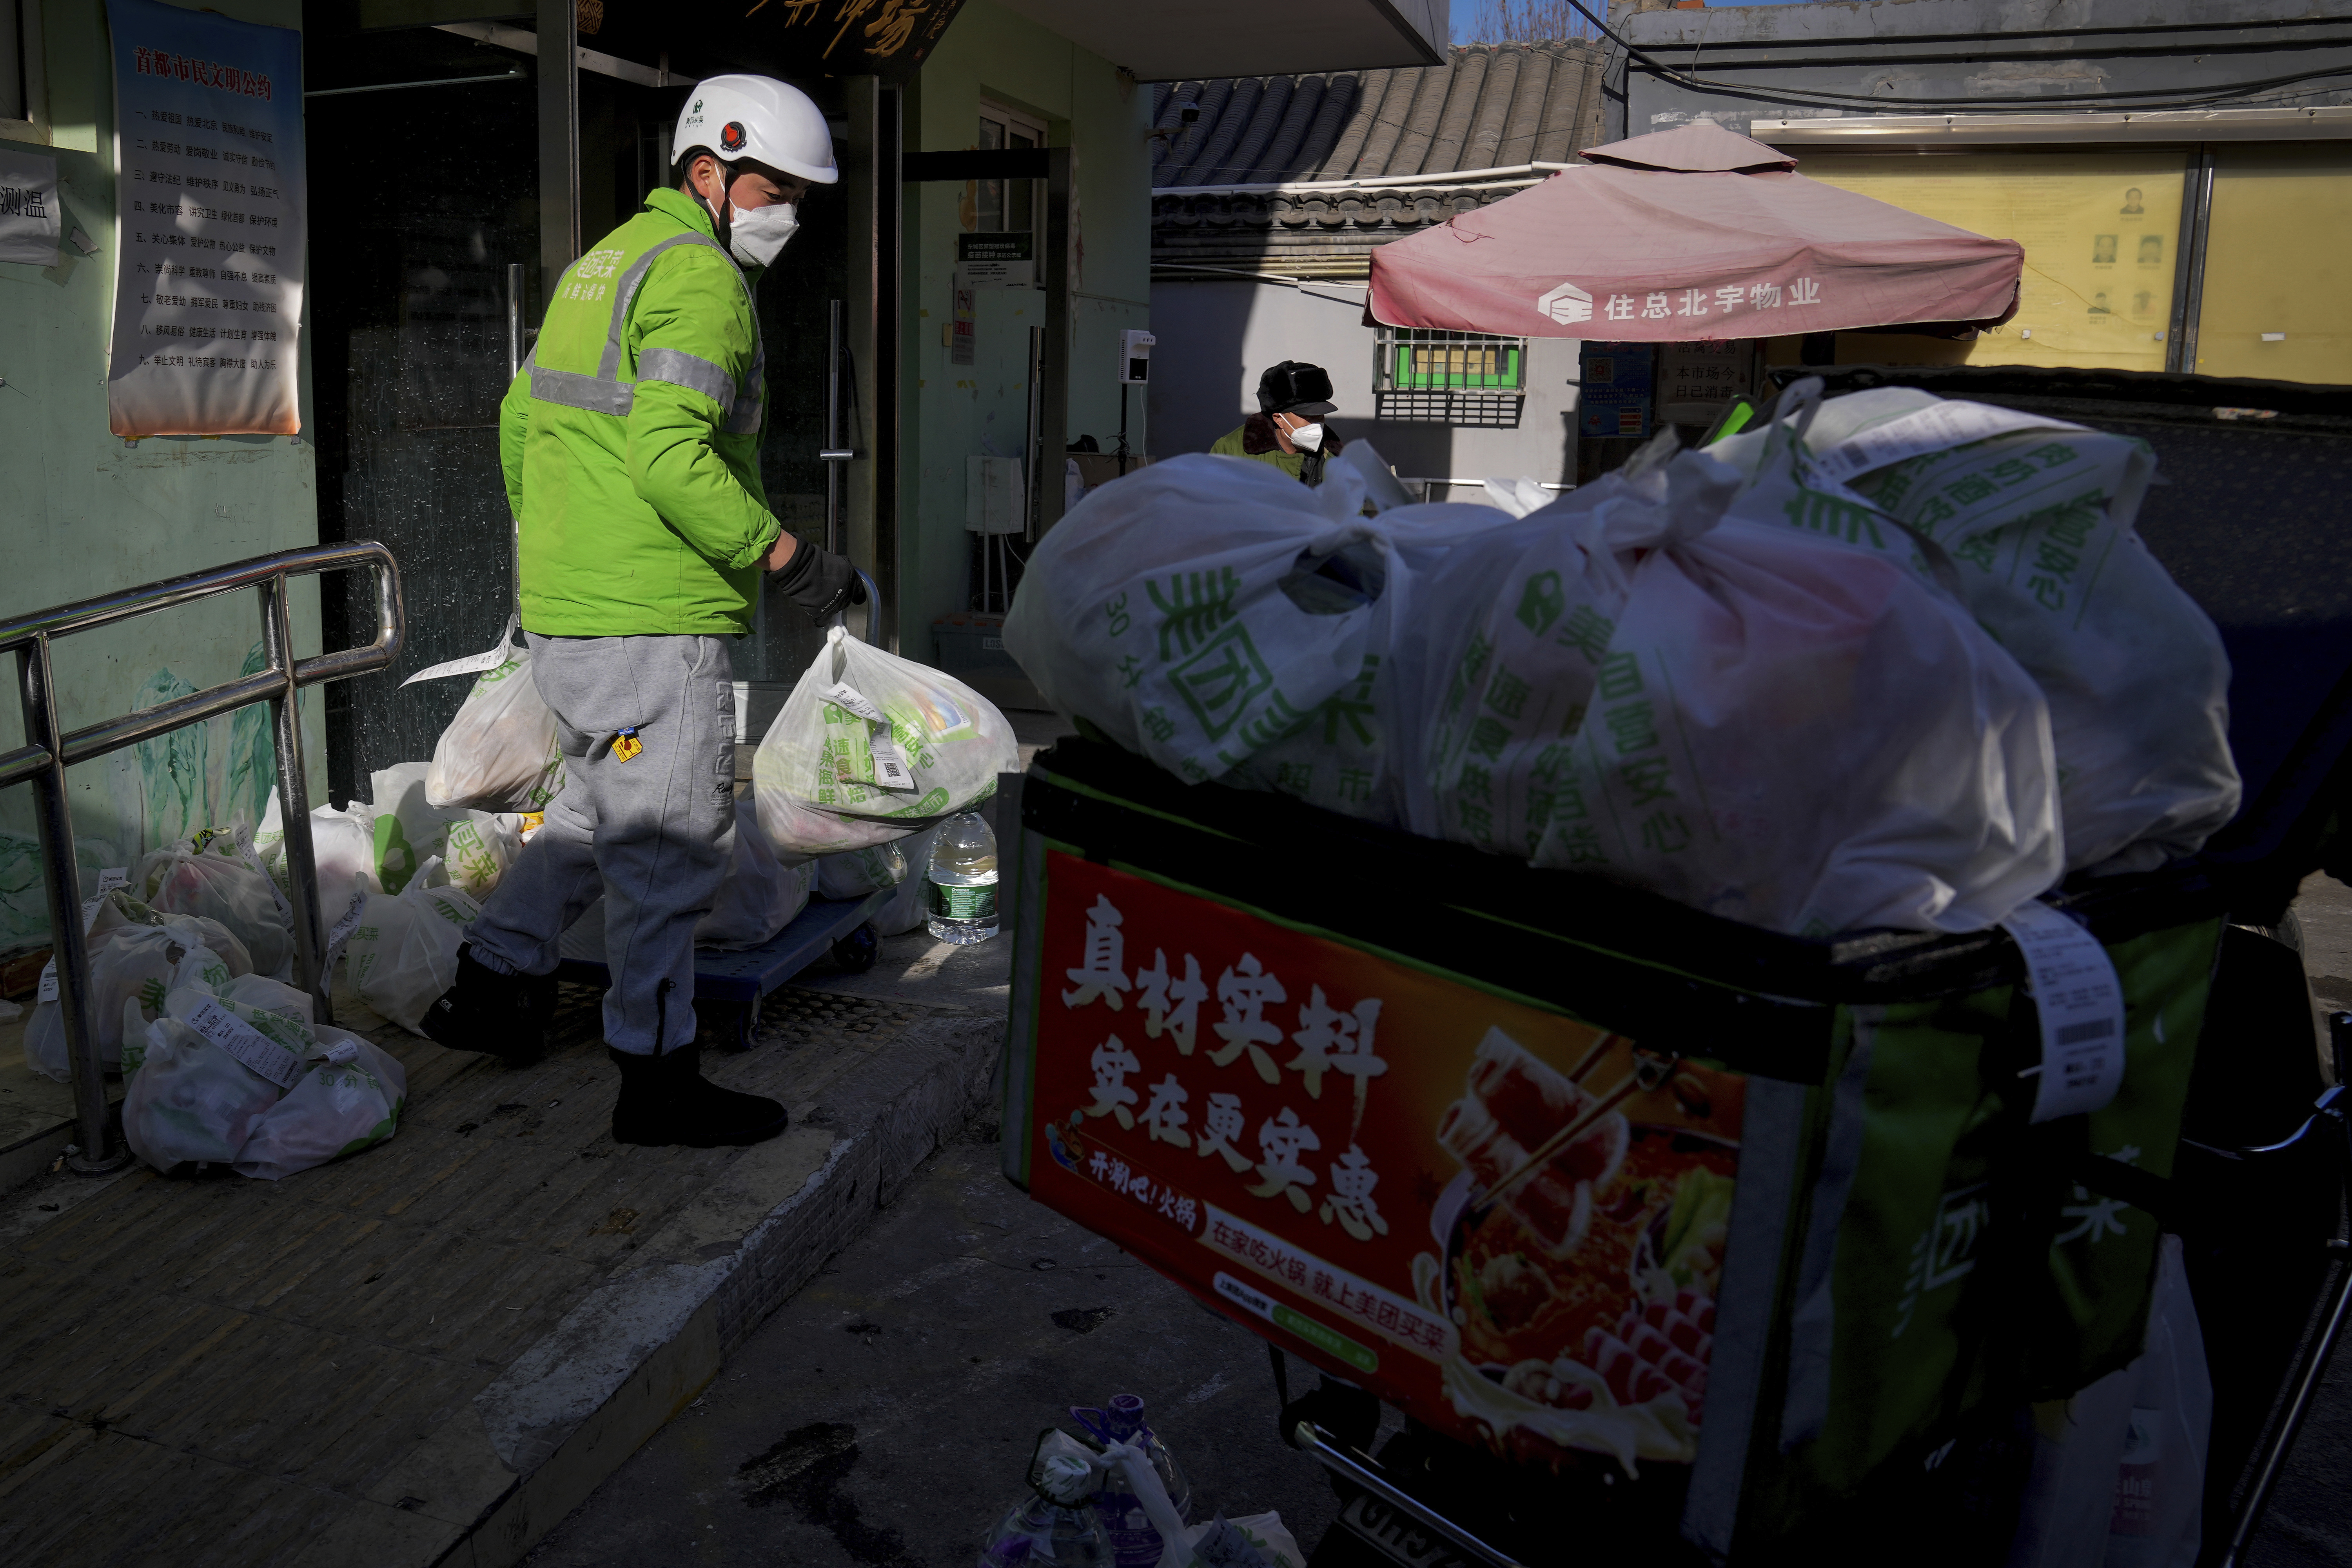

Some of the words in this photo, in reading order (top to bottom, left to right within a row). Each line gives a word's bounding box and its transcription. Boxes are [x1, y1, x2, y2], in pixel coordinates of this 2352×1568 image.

[133, 46, 272, 102] 首都市民文明公约
[187, 116, 218, 130] 热爱北京
[222, 122, 246, 137] 民族和睦
[249, 129, 272, 143] 维护安定
[186, 146, 218, 160] 爱岗敬业
[223, 151, 248, 165] 诚实守信
[251, 157, 275, 171] 勤俭节约
[186, 176, 218, 189] 维护秩序
[223, 181, 245, 194] 见义勇为
[251, 186, 279, 199] 弘扬正气
[0, 185, 47, 218] 测温
[189, 207, 217, 220] 讲究卫生
[221, 211, 245, 224] 绿化首都
[250, 215, 278, 228] 保护环境
[191, 237, 215, 249] 爱护公物
[220, 241, 245, 252] 热心公益
[249, 244, 276, 256] 保护文物
[189, 267, 216, 279] 重教尊师
[221, 269, 247, 281] 自强不息
[252, 272, 276, 285] 提高素质
[191, 297, 218, 309] 拥军爱民
[223, 299, 249, 311] 尊重妇女
[253, 302, 277, 312] 助残济困
[1604, 277, 1821, 320] 住总北宇物业
[189, 328, 216, 338] 健康生活
[220, 328, 247, 340] 计划生育
[251, 330, 276, 341] 增强体魄
[189, 356, 216, 368] 礼待宾客
[220, 358, 246, 369] 胸襟大度
[251, 359, 276, 370] 助人为乐
[1677, 366, 1735, 380] 本市场今
[1061, 893, 1389, 1145] 真材实料
[1080, 1033, 1389, 1241] 实在更实惠
[1212, 1220, 1307, 1285] 在家吃火锅
[1312, 1270, 1447, 1353] 就上美团买菜
